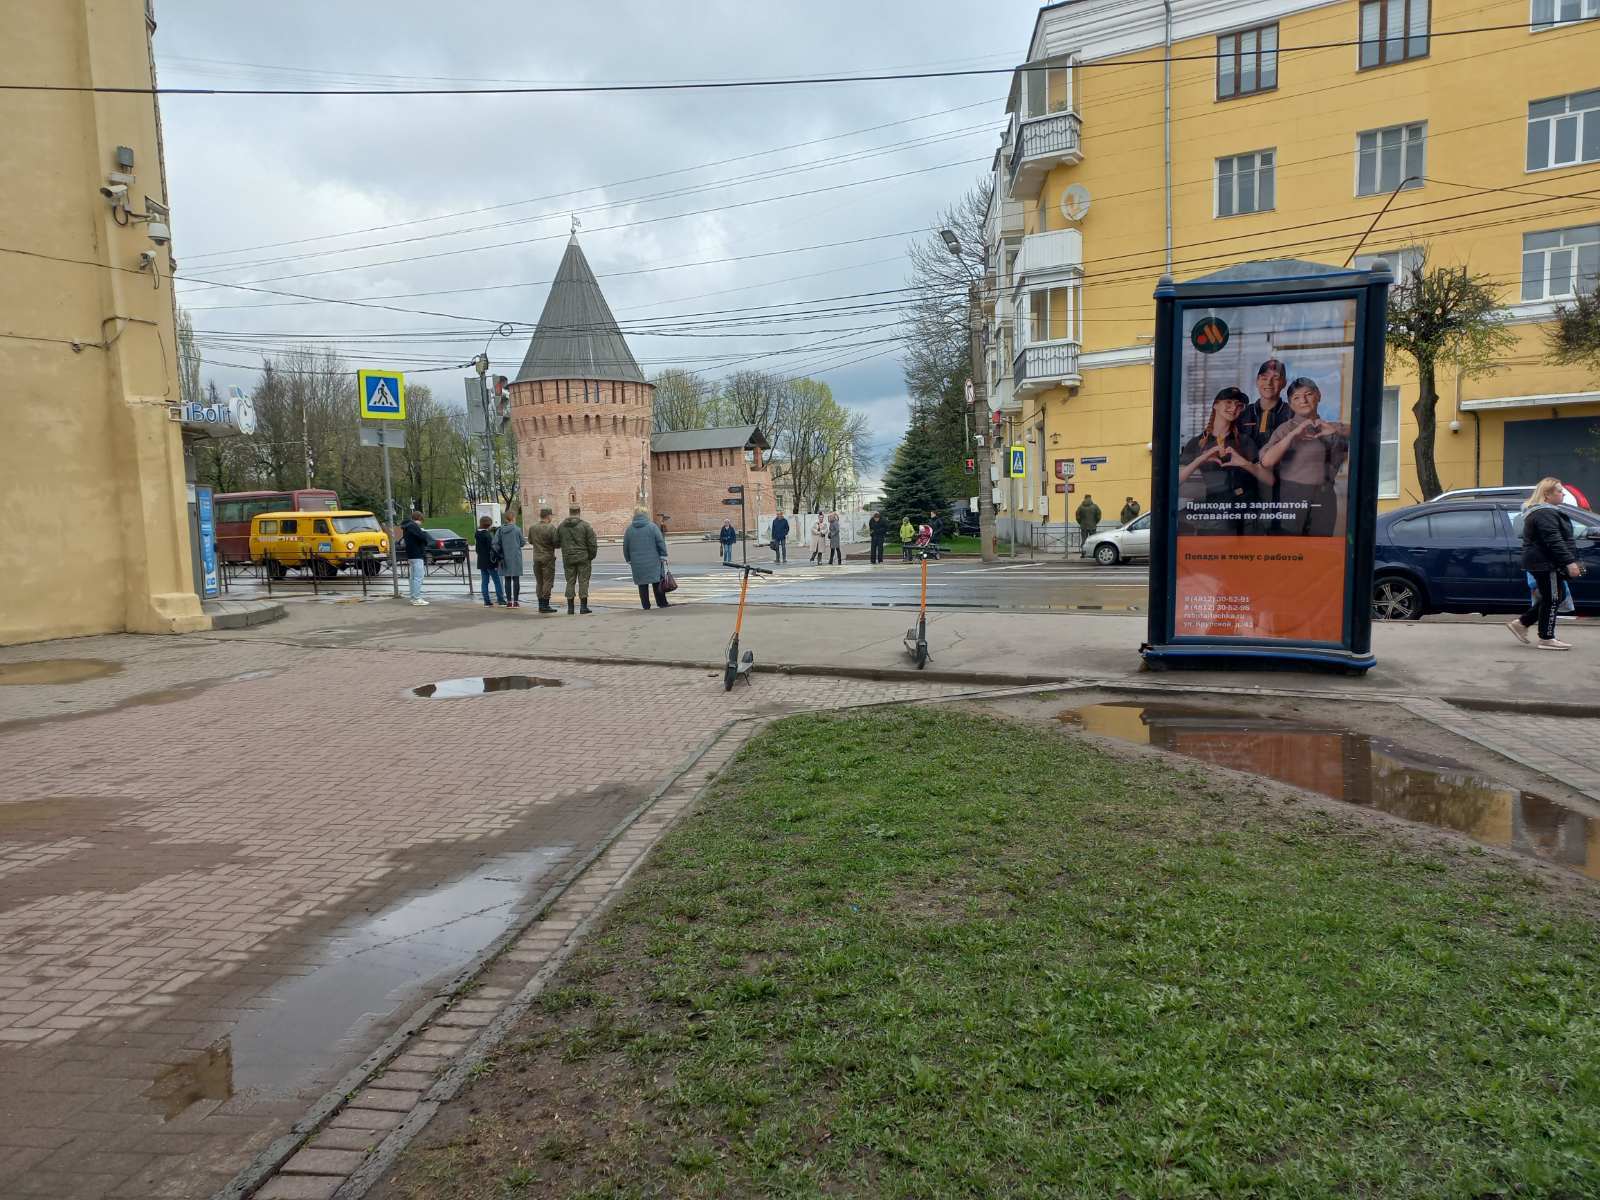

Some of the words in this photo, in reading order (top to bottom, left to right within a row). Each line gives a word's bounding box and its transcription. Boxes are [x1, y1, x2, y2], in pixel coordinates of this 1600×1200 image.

[1186, 501, 1231, 510] Приходи
[1250, 500, 1308, 510] зарплатой
[1186, 512, 1241, 520] оставайся
[1228, 554, 1255, 562] точку
[1264, 552, 1304, 561] работой
